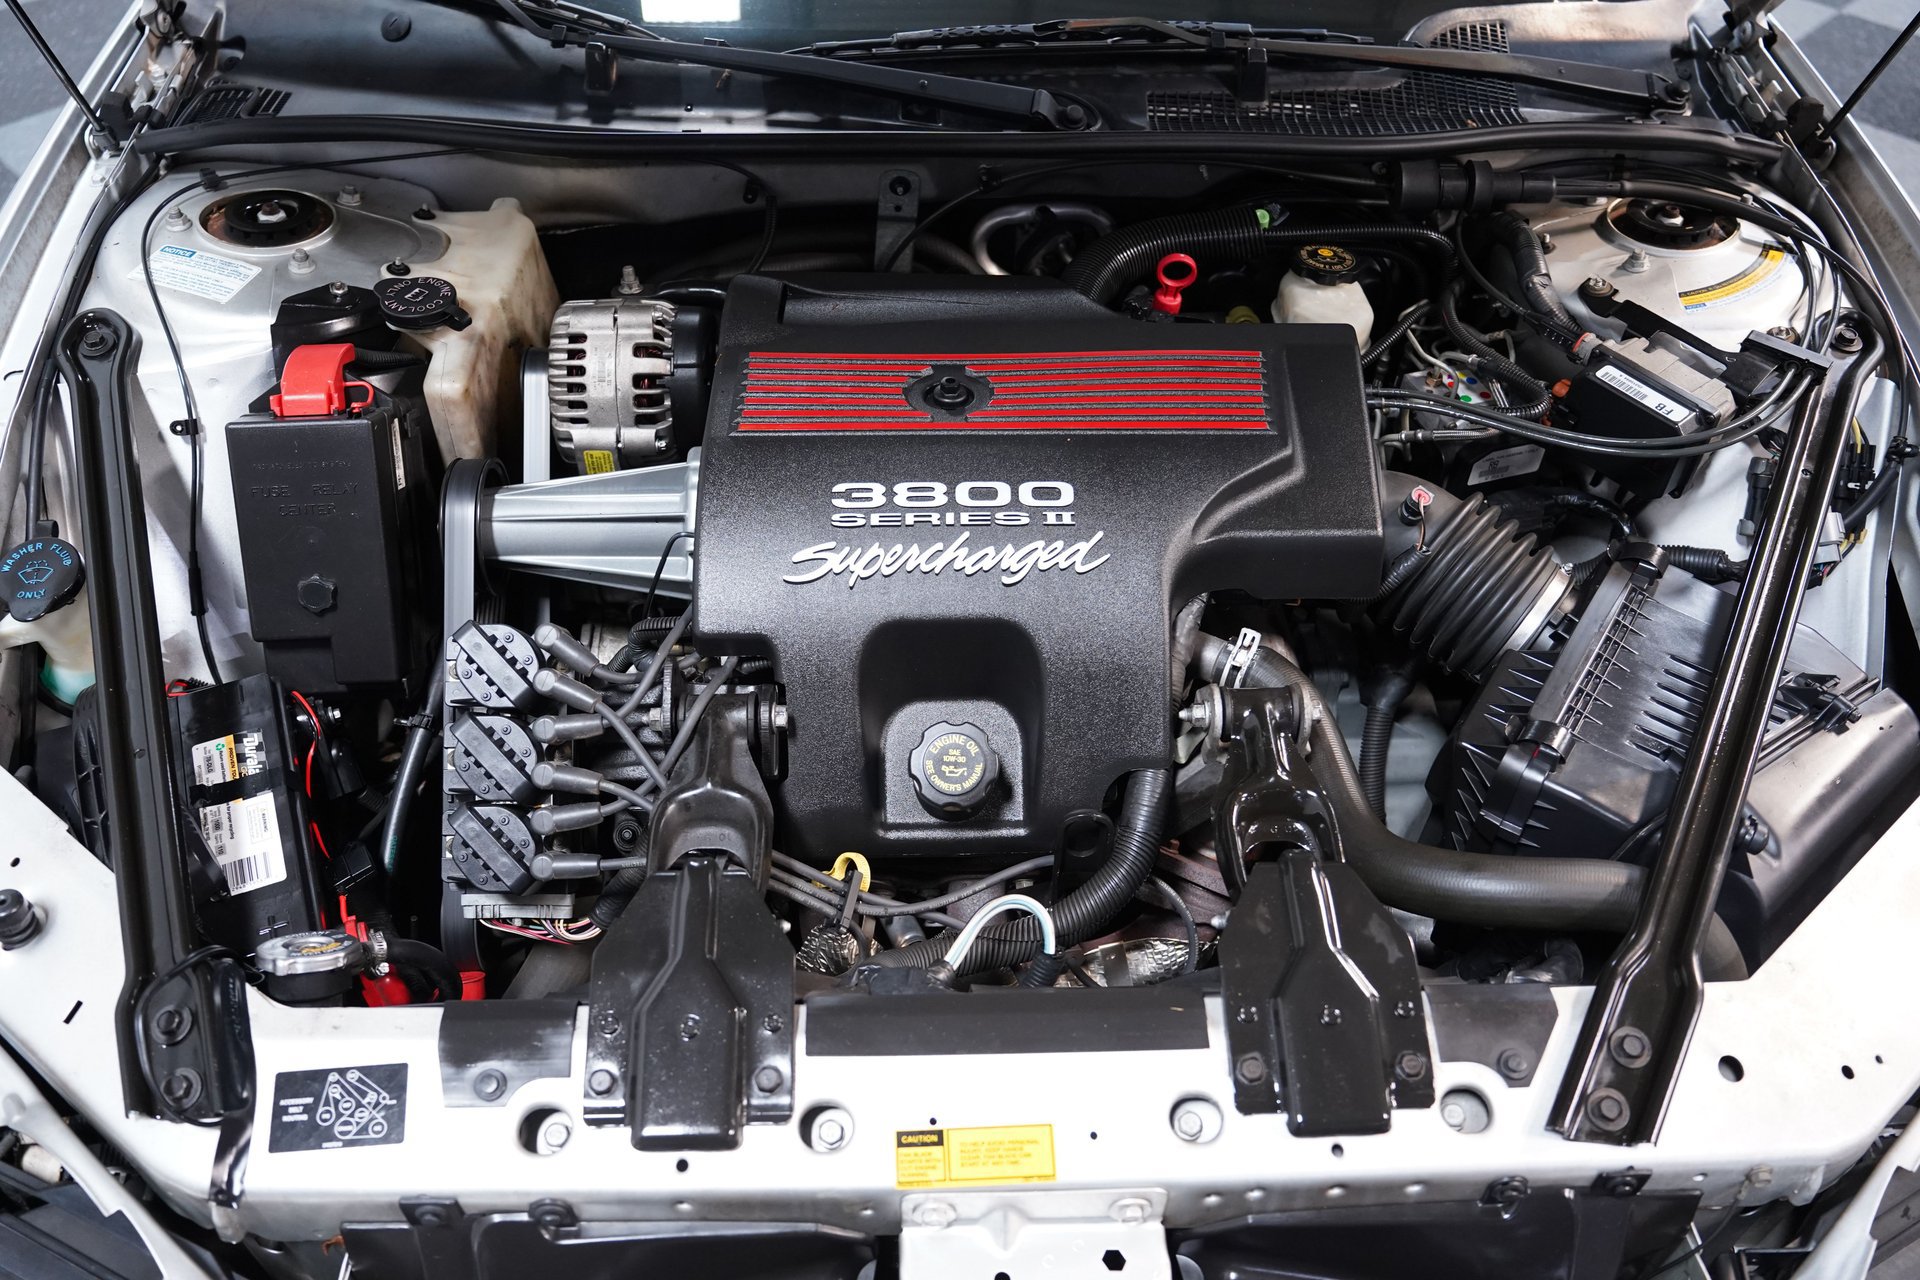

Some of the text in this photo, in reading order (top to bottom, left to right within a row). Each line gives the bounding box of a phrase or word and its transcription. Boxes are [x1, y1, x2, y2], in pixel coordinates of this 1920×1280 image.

[162, 246, 194, 257] NOTICE
[384, 278, 452, 313] ENGINE COOLANT ONLY
[251, 481, 360, 498] FUSE RELAY
[831, 481, 1075, 509] 3800
[279, 502, 336, 517] CENTER
[830, 511, 1076, 527] SERIES II
[1, 542, 72, 573] WASHER FLUID
[783, 531, 1111, 589] Supercharged
[17, 588, 46, 600] ONLY
[243, 733, 263, 776] Durala
[929, 734, 980, 757] ENGINE OIL
[228, 747, 236, 769] PROVEN
[943, 755, 967, 763] 10W-30
[925, 759, 983, 792] SEE OWNER'S MANUAL
[901, 1133, 938, 1144] CAUTION
